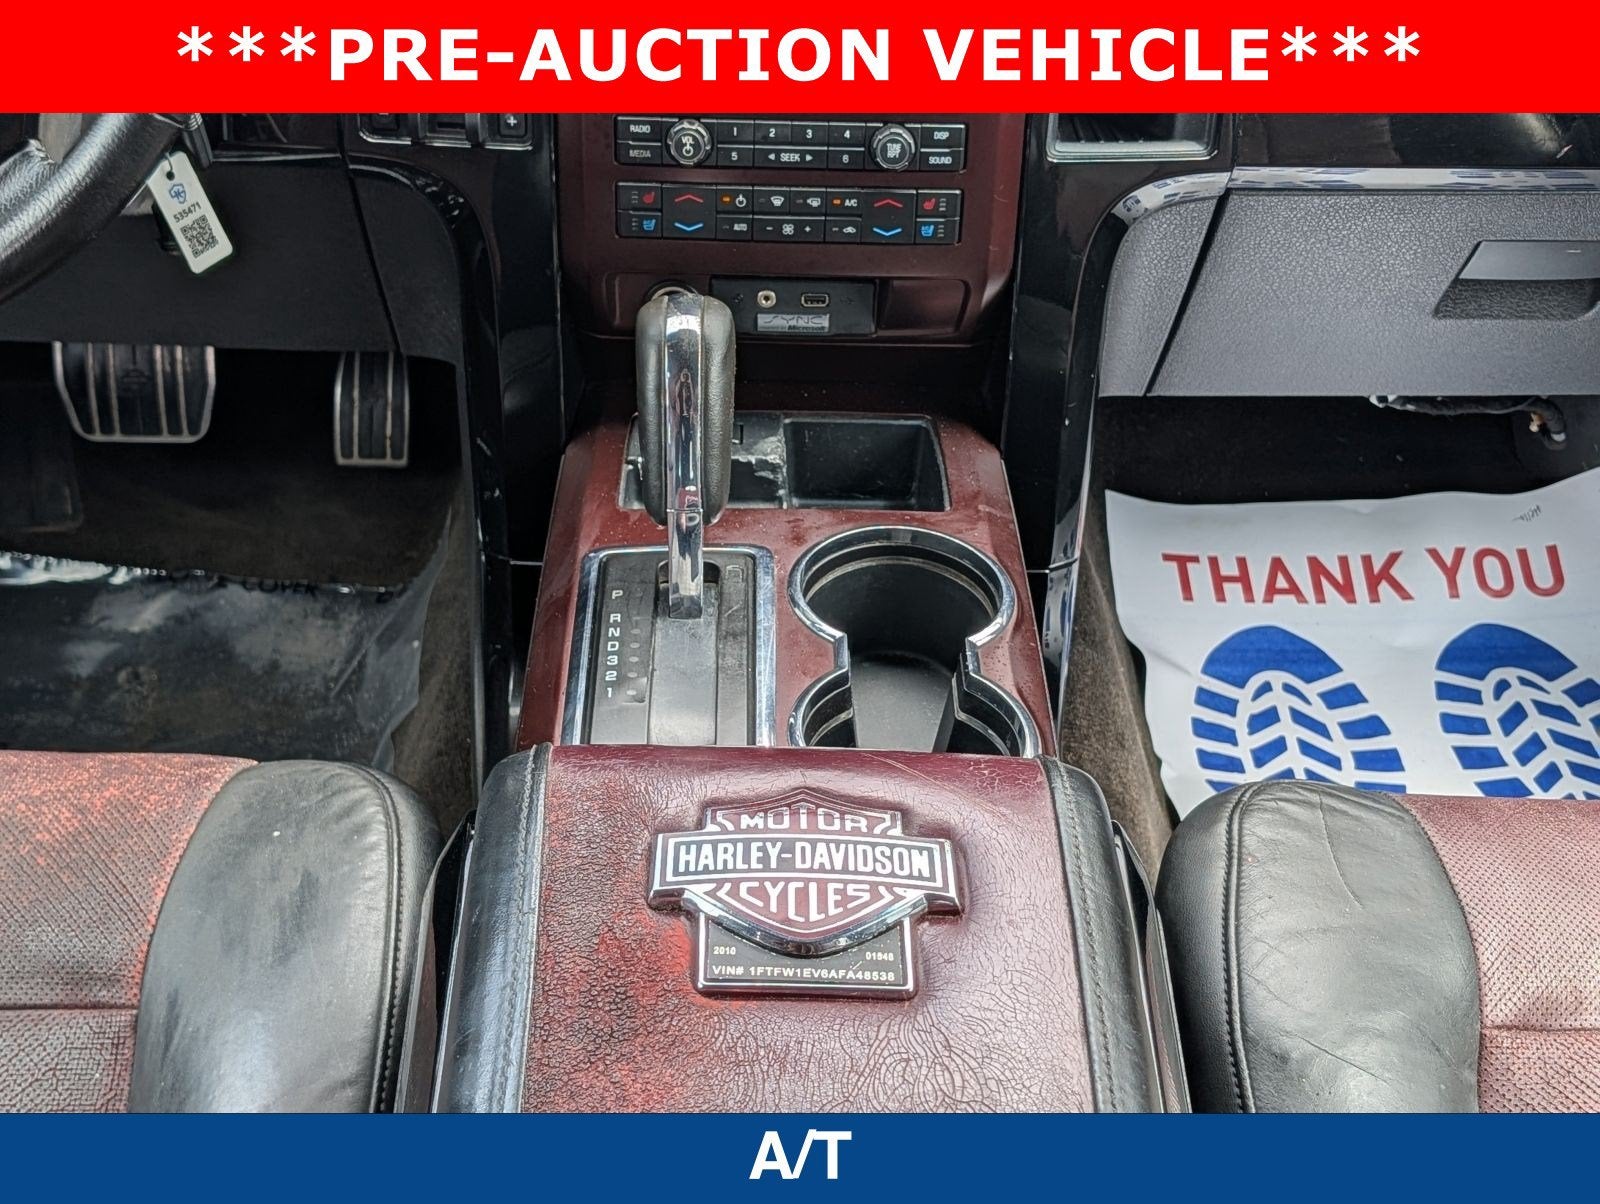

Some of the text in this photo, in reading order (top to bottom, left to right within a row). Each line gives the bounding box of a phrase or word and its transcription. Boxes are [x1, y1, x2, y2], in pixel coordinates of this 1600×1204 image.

[629, 124, 651, 133] RADIO
[732, 126, 738, 136] 1
[768, 128, 776, 138] 2
[805, 129, 813, 139] 3
[843, 130, 851, 140] 4
[933, 131, 950, 140] DISP
[681, 136, 695, 144] VOL
[629, 149, 651, 158] MEDIA
[731, 152, 738, 161] 5
[780, 153, 801, 162] SEEK
[842, 154, 850, 164] 6
[928, 156, 953, 165] SOUND
[844, 198, 858, 208] A/C
[173, 201, 202, 223] 535471
[763, 315, 823, 325] SYNC
[1161, 544, 1566, 604] THANK YOU
[611, 590, 623, 599] P
[609, 613, 621, 623] R
[608, 627, 620, 637] N
[607, 642, 619, 651] D
[606, 655, 618, 665] 3
[605, 670, 617, 681] 2
[606, 687, 612, 698] 1
[740, 802, 868, 832] MOTOR
[678, 841, 931, 878] HARLEY-DAVIDSON
[739, 880, 871, 923] CYCLES
[713, 946, 736, 955] 2010
[712, 965, 744, 976] VIN#
